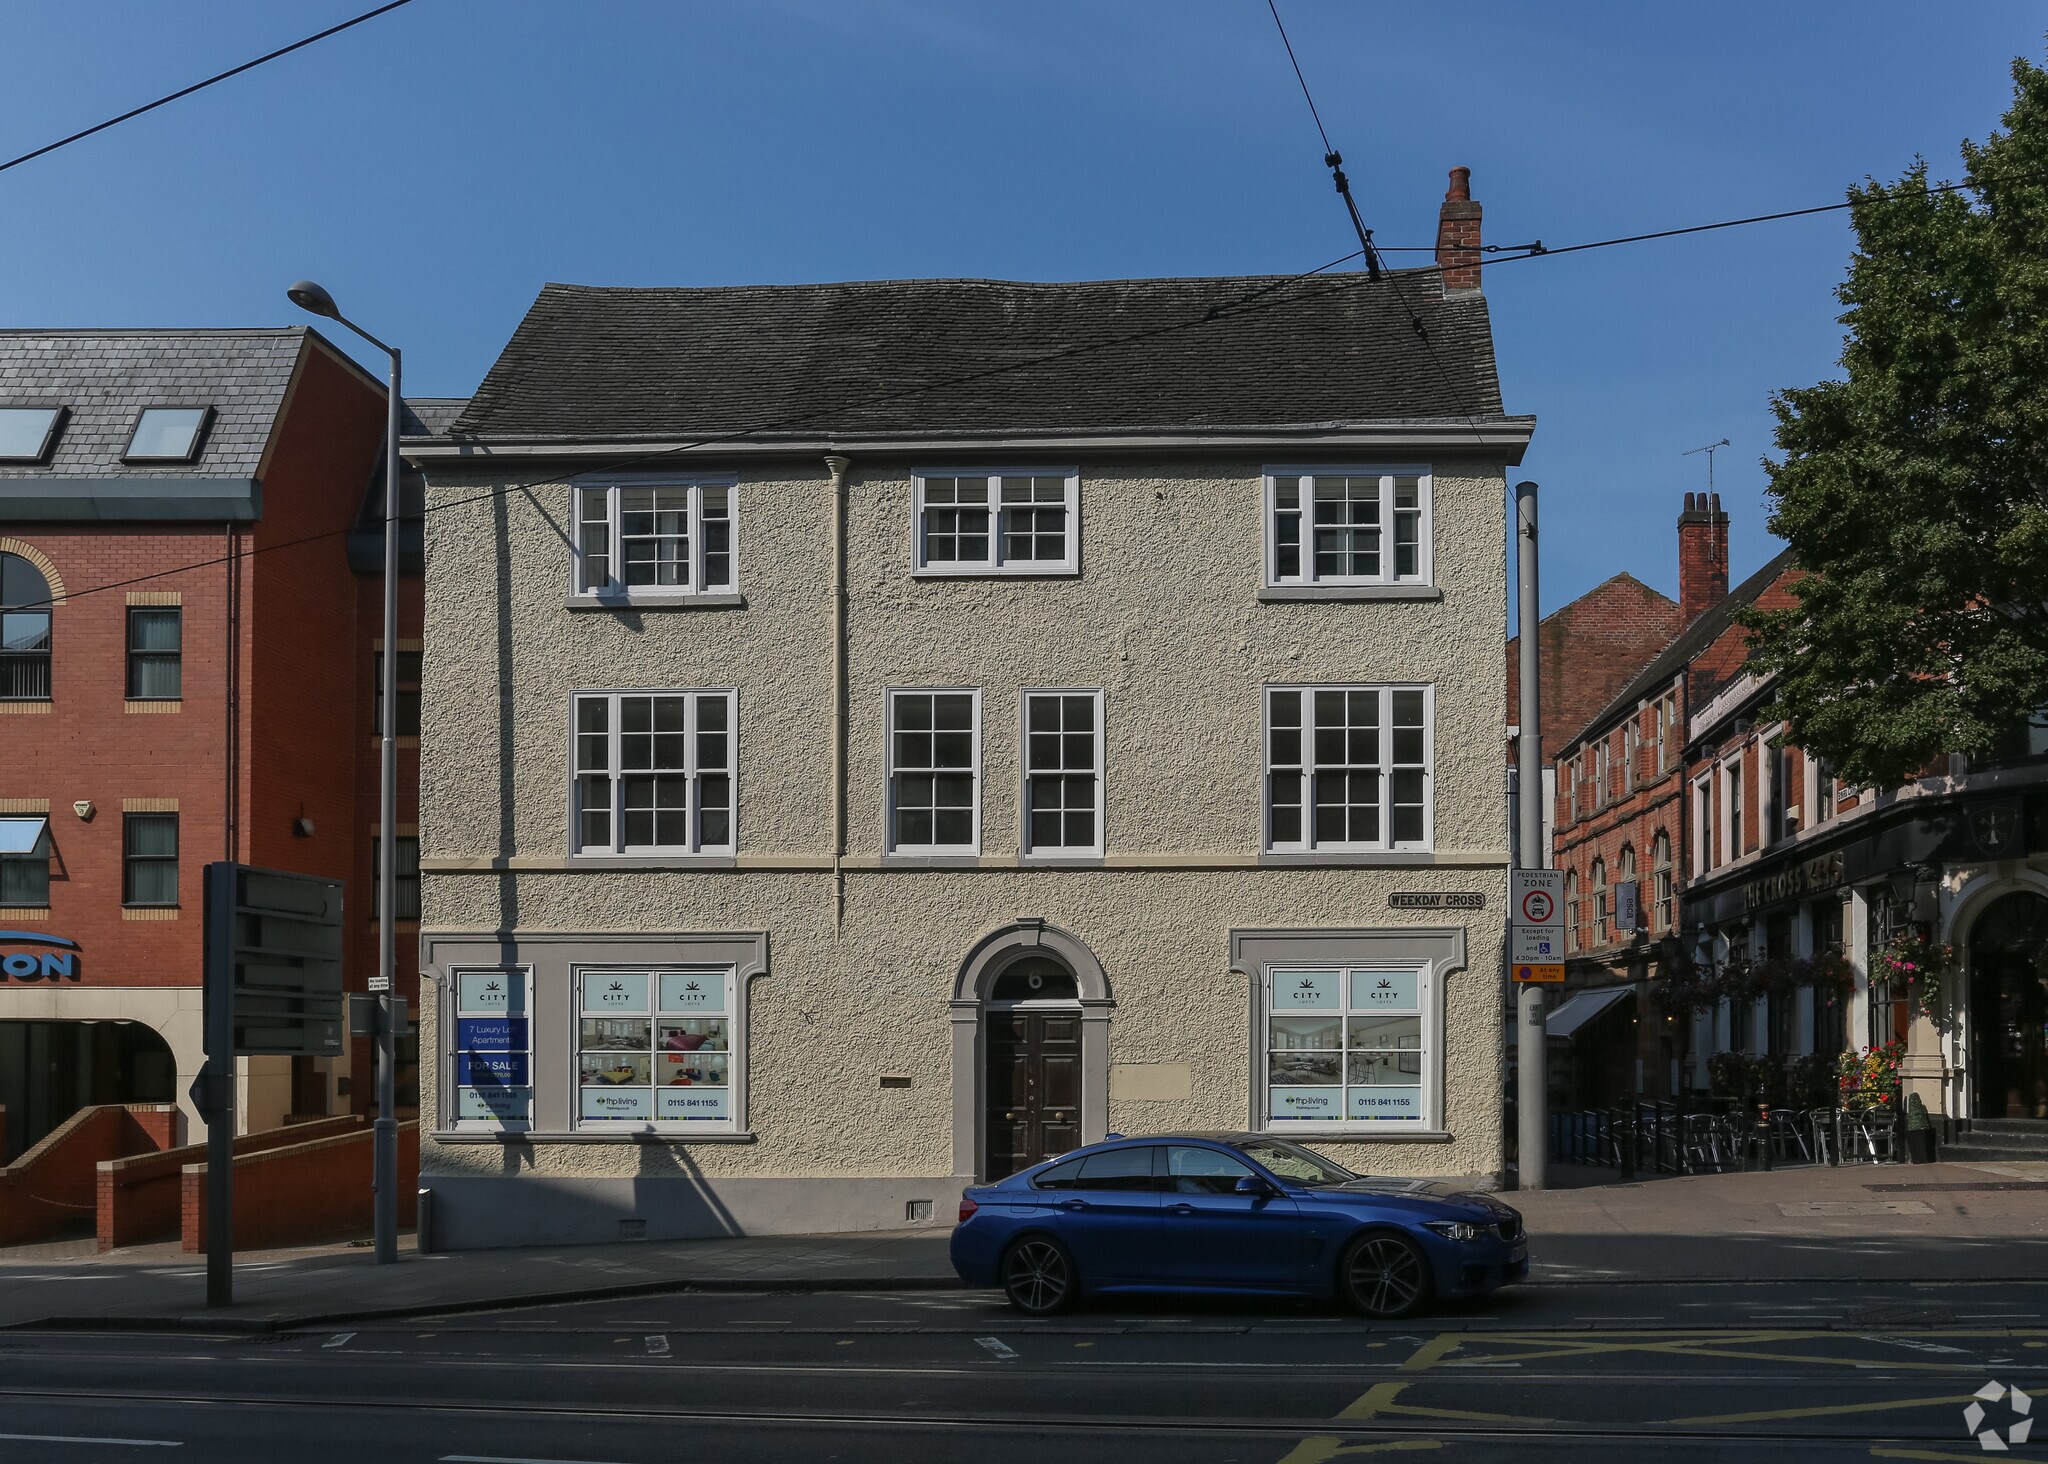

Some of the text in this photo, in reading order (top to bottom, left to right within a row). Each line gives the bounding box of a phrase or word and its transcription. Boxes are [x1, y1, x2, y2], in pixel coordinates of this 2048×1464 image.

[1523, 879, 1553, 887] ZONE
[1743, 881, 1761, 910] THE
[1764, 867, 1802, 902] CROSS
[1391, 895, 1483, 906] WEEKDAY CROSS
[1626, 898, 1634, 919] esca
[1028, 968, 1043, 990] 6
[469, 1025, 475, 1033] 7
[476, 1025, 501, 1035] Luxury
[468, 1061, 519, 1070] FOR SALE
[667, 1099, 718, 1107] 0115 841 1155
[1358, 1098, 1410, 1106] 0115 841 1155
